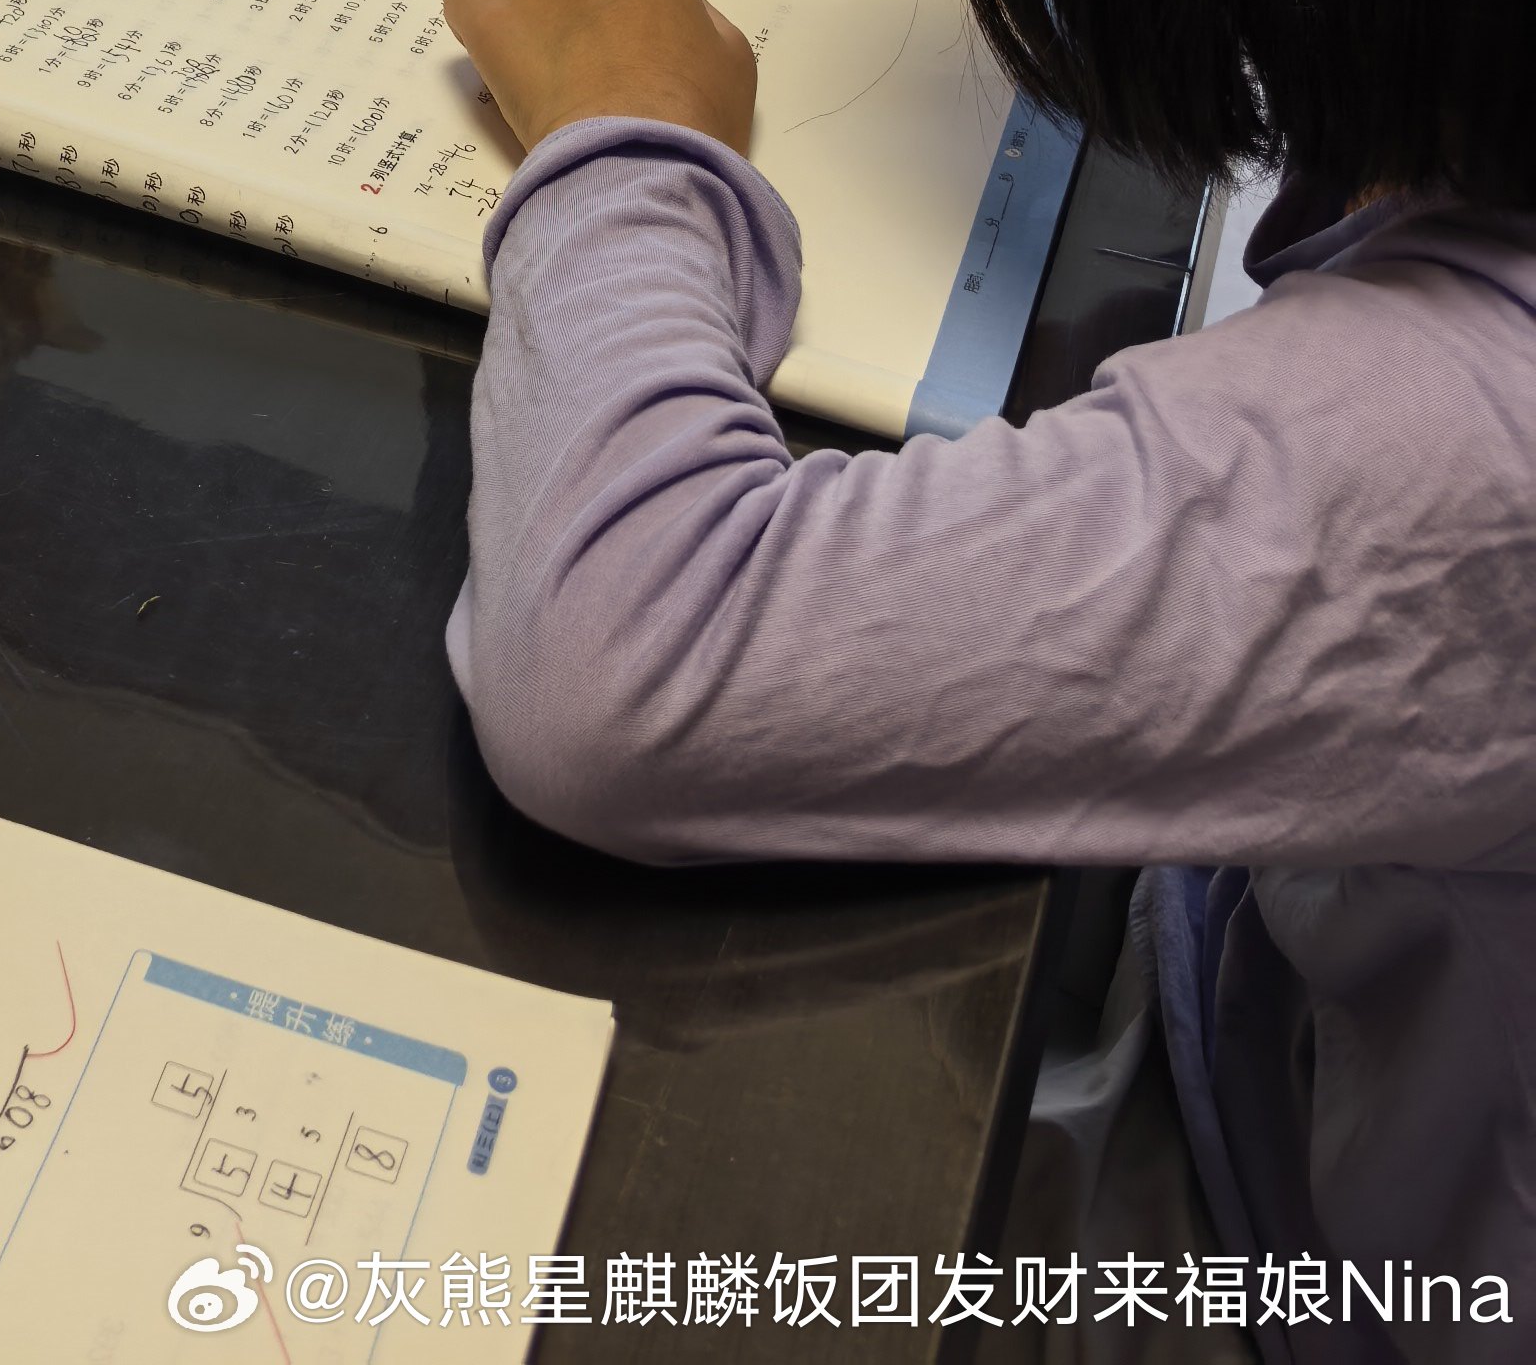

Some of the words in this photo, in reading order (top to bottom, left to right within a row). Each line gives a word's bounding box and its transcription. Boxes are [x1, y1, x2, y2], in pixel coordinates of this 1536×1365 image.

[358, 123, 424, 195] 2.列竖式计算。
[244, 989, 357, 1046] 提升练
